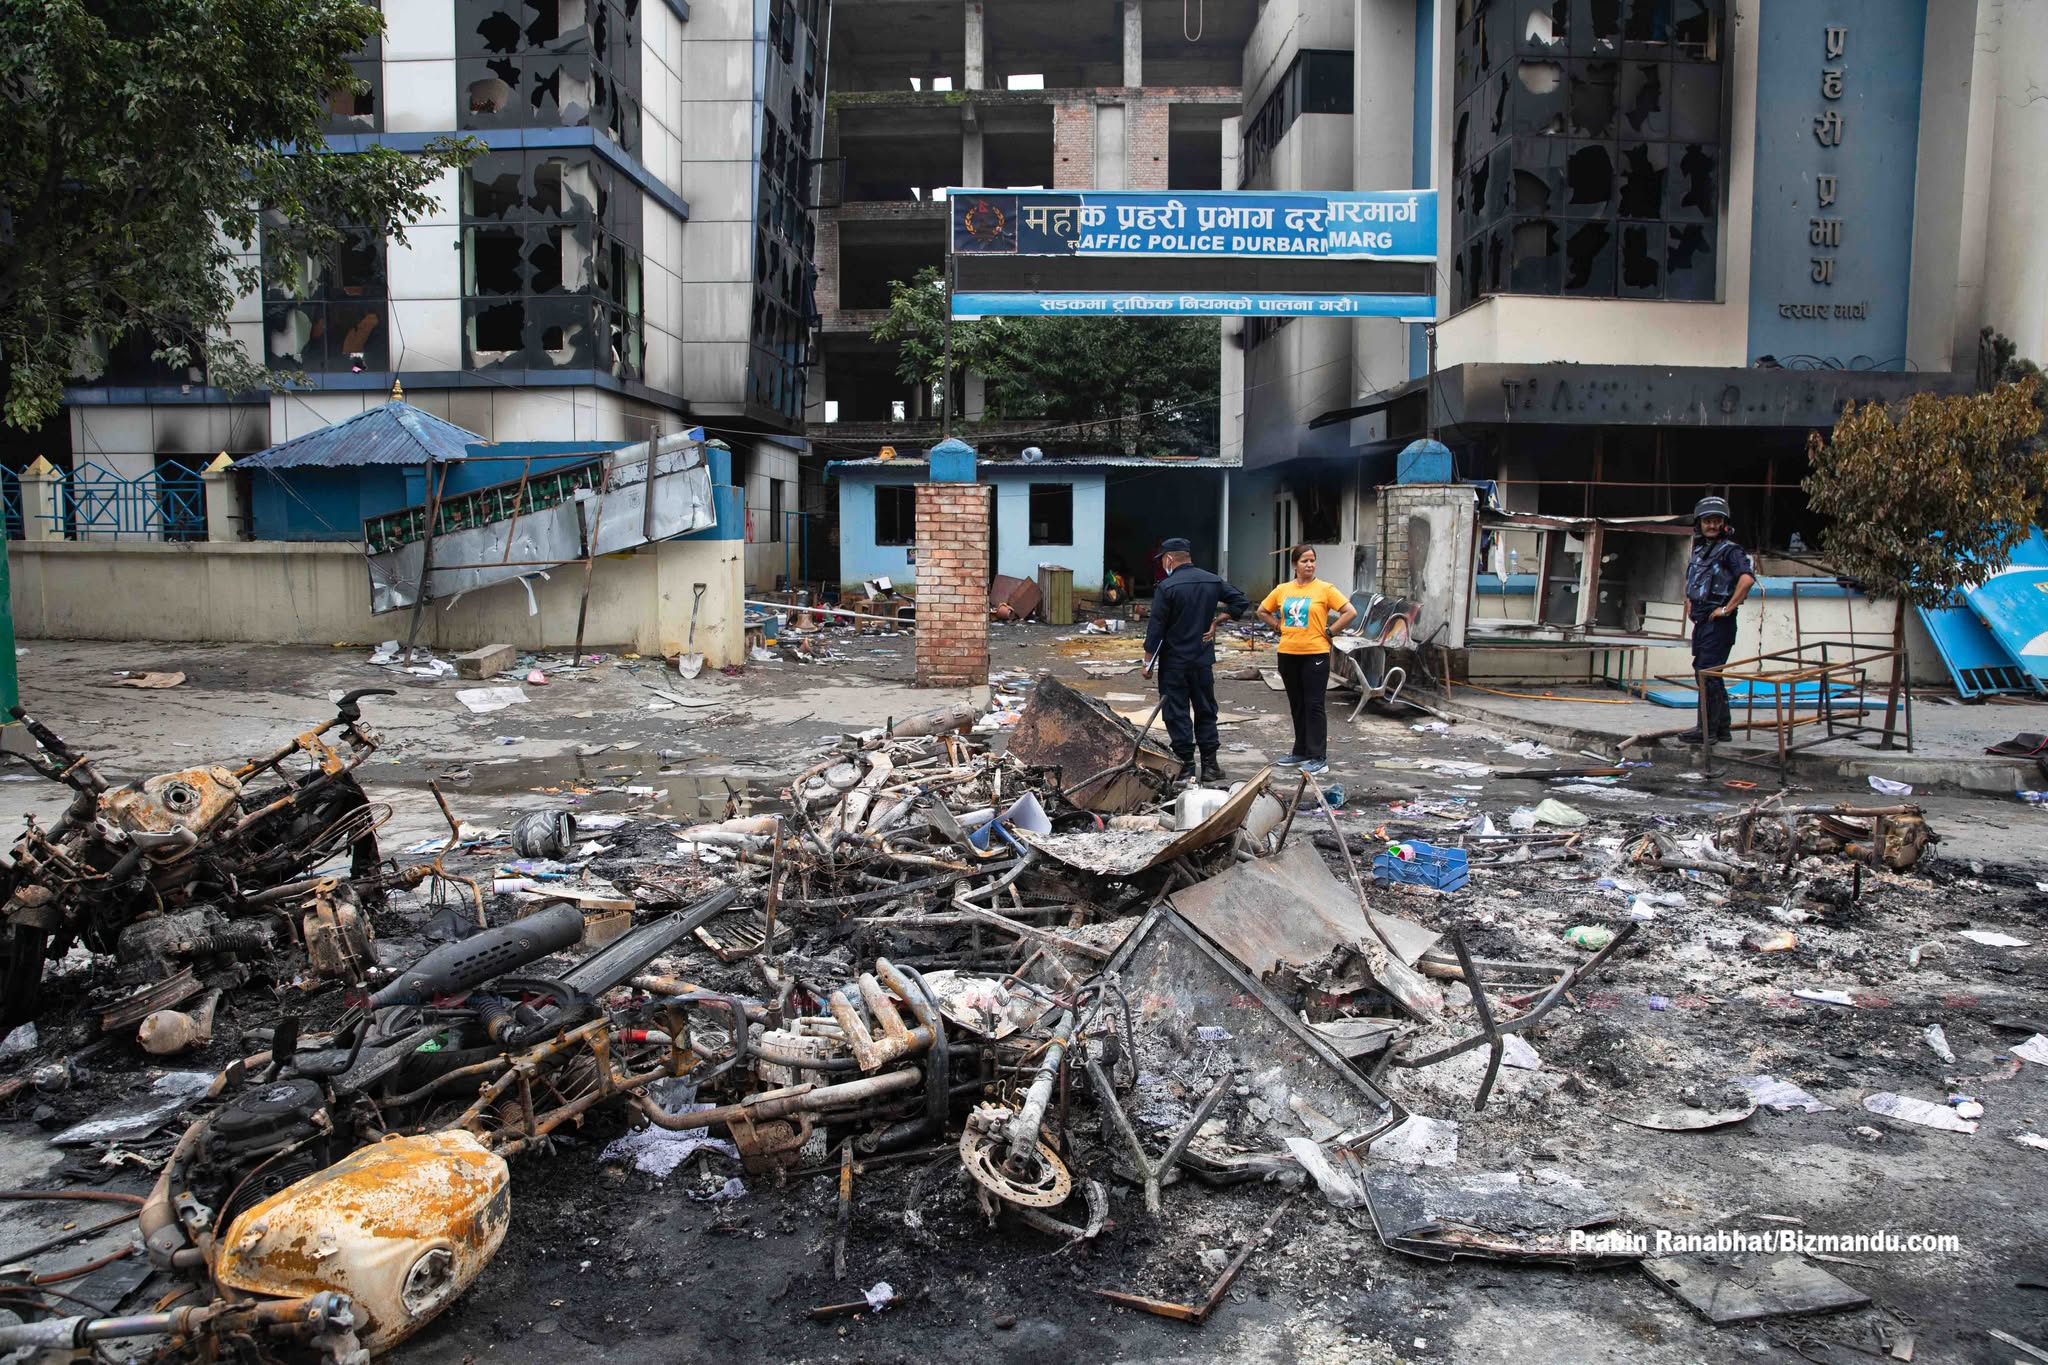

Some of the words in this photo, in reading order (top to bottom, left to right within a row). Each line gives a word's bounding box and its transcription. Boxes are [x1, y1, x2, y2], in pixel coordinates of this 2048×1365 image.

[1814, 25, 1848, 147] प्रहरी
[1116, 199, 1187, 231] प्रहरी
[1197, 206, 1275, 231] प्रभाग
[1079, 233, 1141, 249] AFFIC
[1148, 234, 1225, 251] POLICE
[1329, 231, 1393, 249] MARG
[1810, 173, 1843, 286] प्रभाग
[1112, 296, 1174, 312] ट्राफिक
[1179, 296, 1253, 310] नियमको
[1258, 299, 1314, 311] पालना
